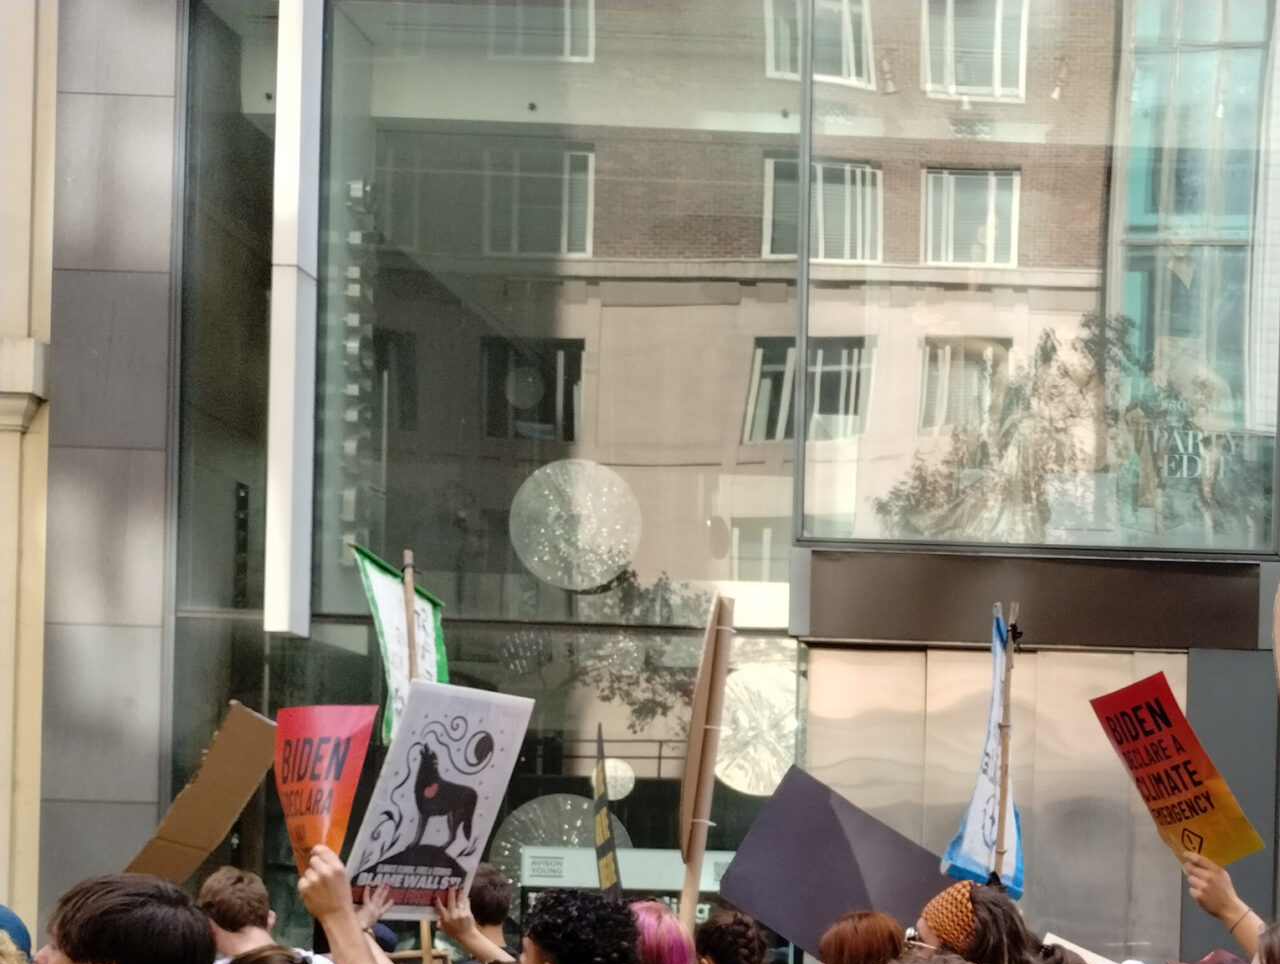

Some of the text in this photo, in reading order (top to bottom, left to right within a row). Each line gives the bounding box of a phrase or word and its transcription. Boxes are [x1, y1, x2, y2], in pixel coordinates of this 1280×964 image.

[1104, 696, 1173, 747] BIDEN
[280, 735, 352, 785] BIDEN
[1121, 733, 1187, 772] DECLARE A
[1135, 759, 1204, 803] CLIMATE
[402, 872, 442, 890] WALL
